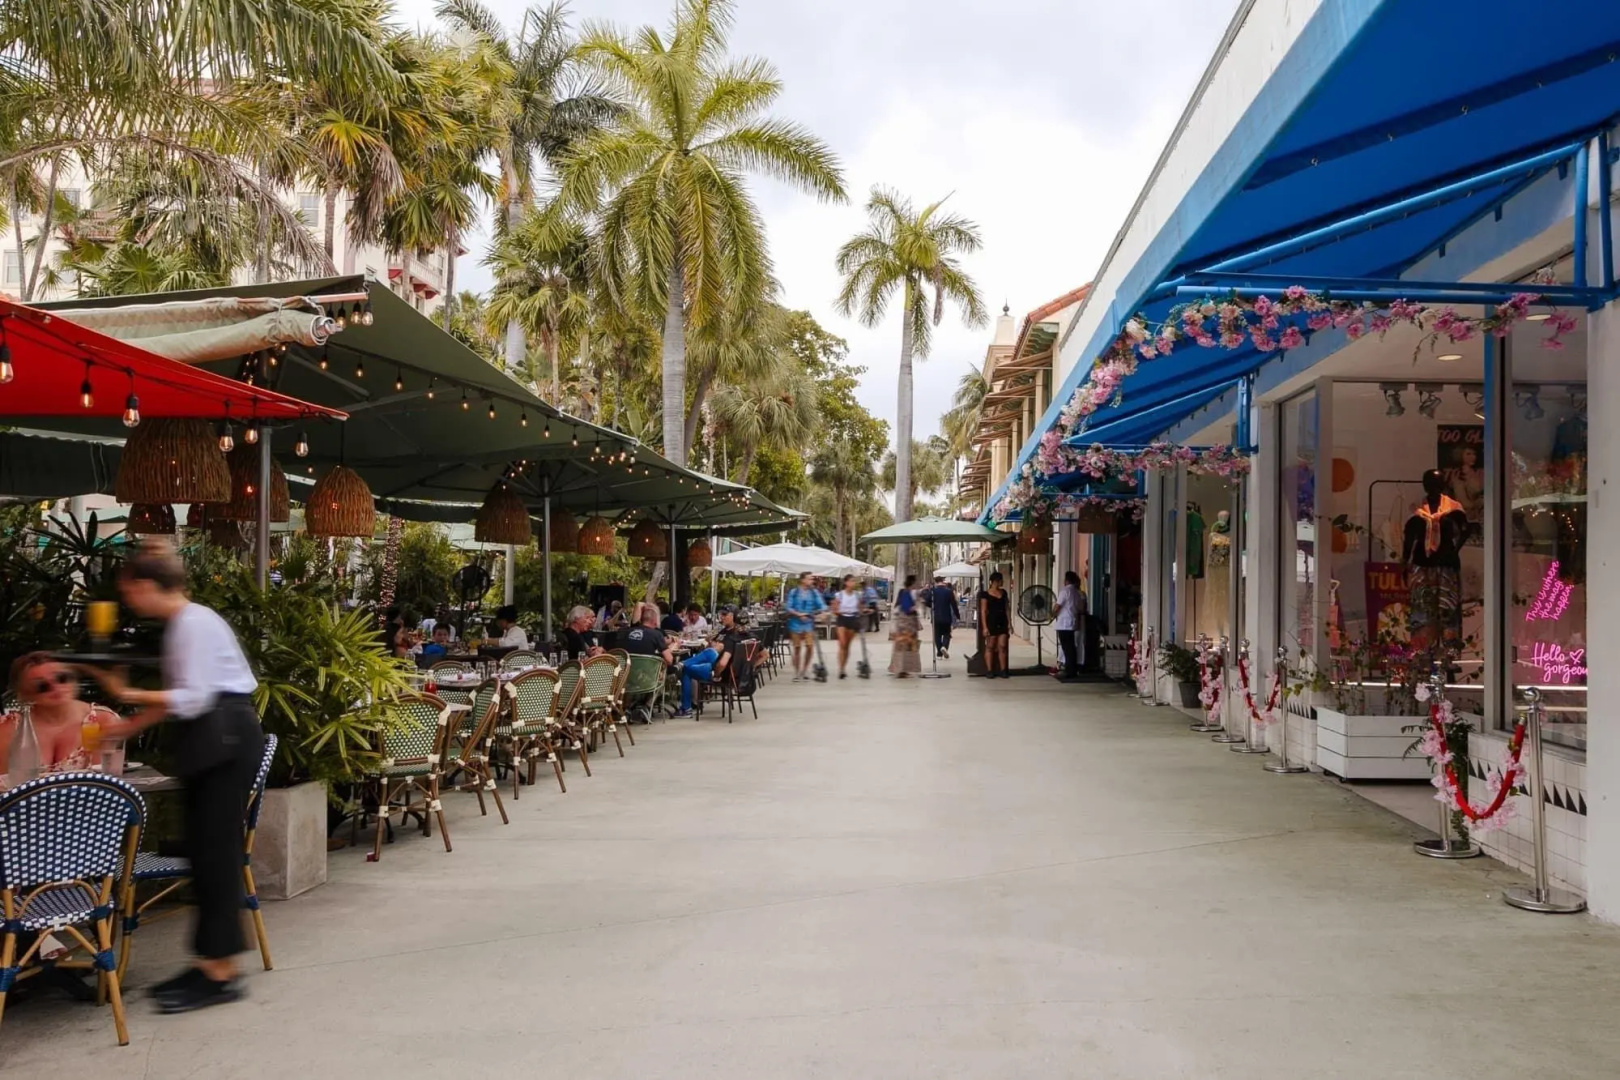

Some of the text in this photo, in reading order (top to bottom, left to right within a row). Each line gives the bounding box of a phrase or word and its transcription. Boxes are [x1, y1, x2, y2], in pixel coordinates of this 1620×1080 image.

[1525, 560, 1559, 621] This is where
[1539, 602, 1553, 619] the
[1531, 642, 1565, 667] Hello
[1543, 662, 1588, 684] gorgeou
